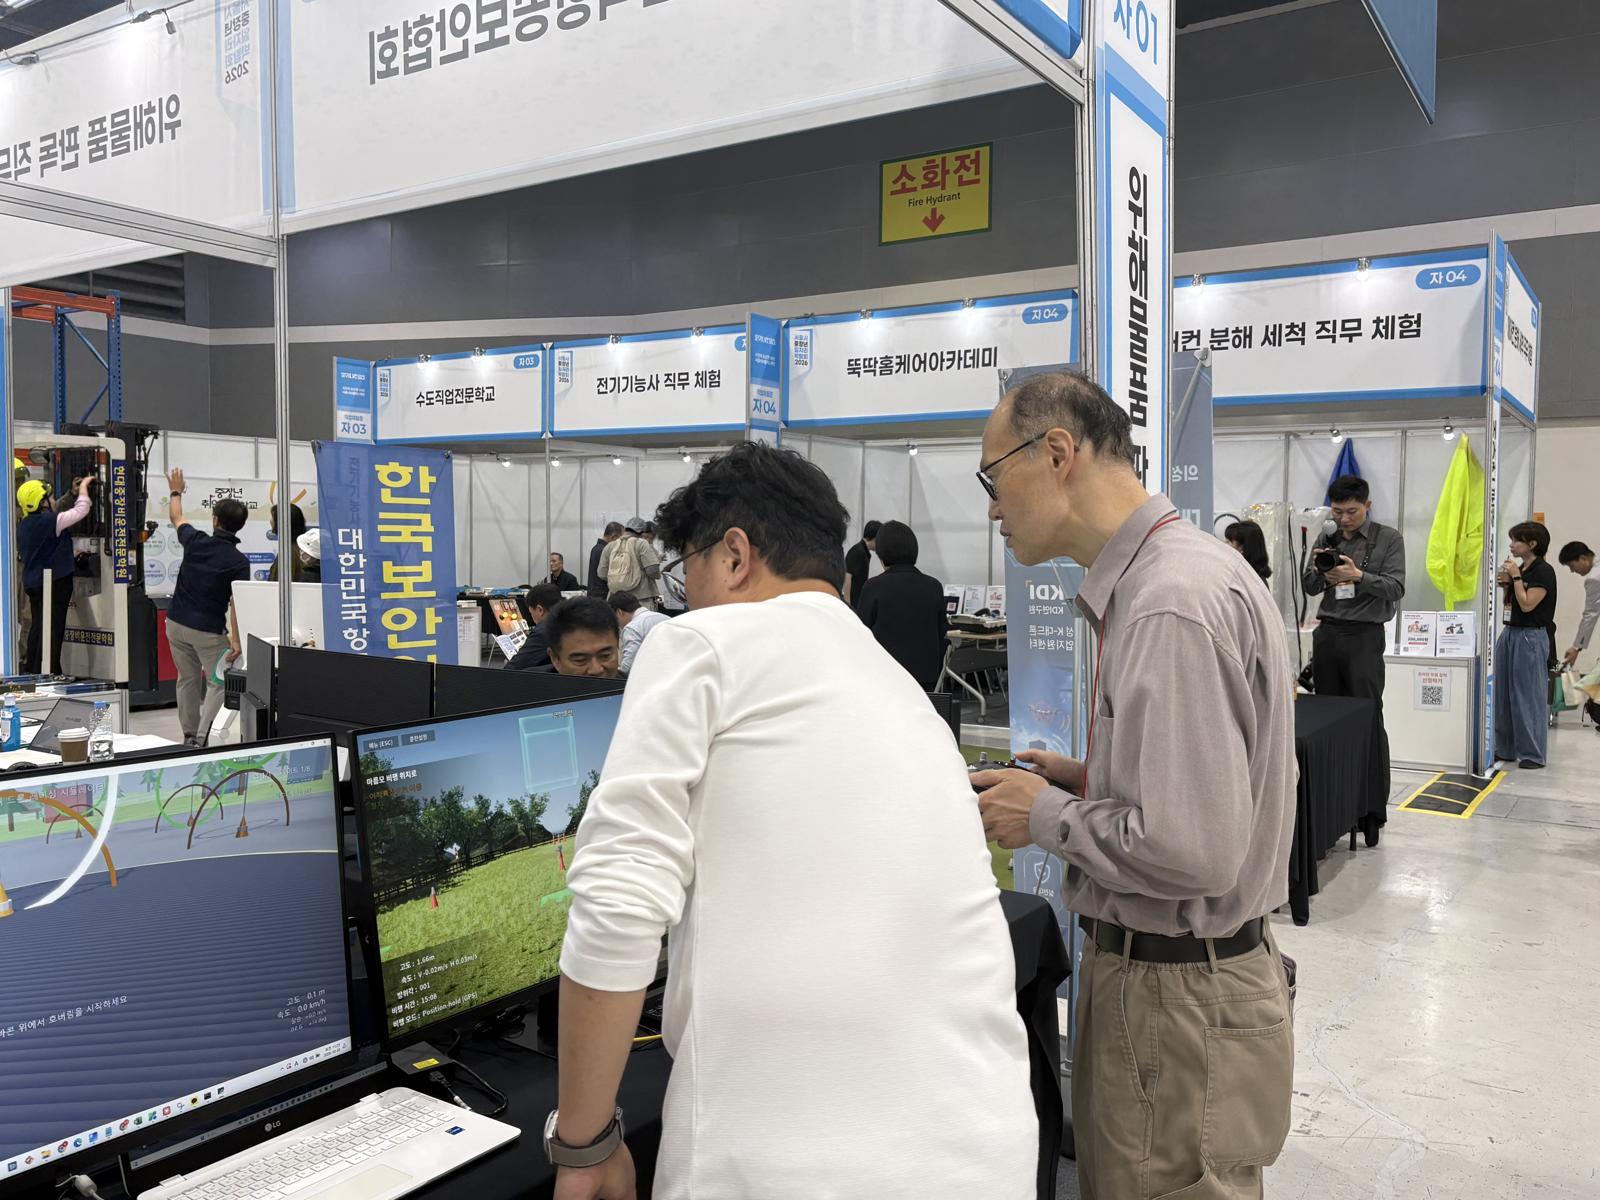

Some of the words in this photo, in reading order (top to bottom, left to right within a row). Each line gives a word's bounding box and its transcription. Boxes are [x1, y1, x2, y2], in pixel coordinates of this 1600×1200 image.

[890, 150, 981, 196] 소화전
[908, 198, 924, 208] Fire
[926, 192, 960, 206] Hydrant
[1209, 326, 1252, 351] 분해
[1260, 322, 1306, 348] 세척
[1315, 318, 1362, 344] 직무
[1371, 312, 1422, 340] 체험
[846, 346, 998, 378] 뚝딱홈케어아카데미
[416, 386, 496, 408] 수도직업전문학교
[596, 373, 660, 395] 전기기능사
[664, 372, 690, 390] 직무
[694, 370, 722, 388] 체험
[374, 462, 442, 663] 한국보안
[338, 528, 370, 656] 대한민국항
[0, 1026, 15, 1038] 바콘
[18, 1018, 45, 1032] 위에서
[48, 1007, 83, 1024] 호버링을
[86, 995, 128, 1013] 시작하세요
